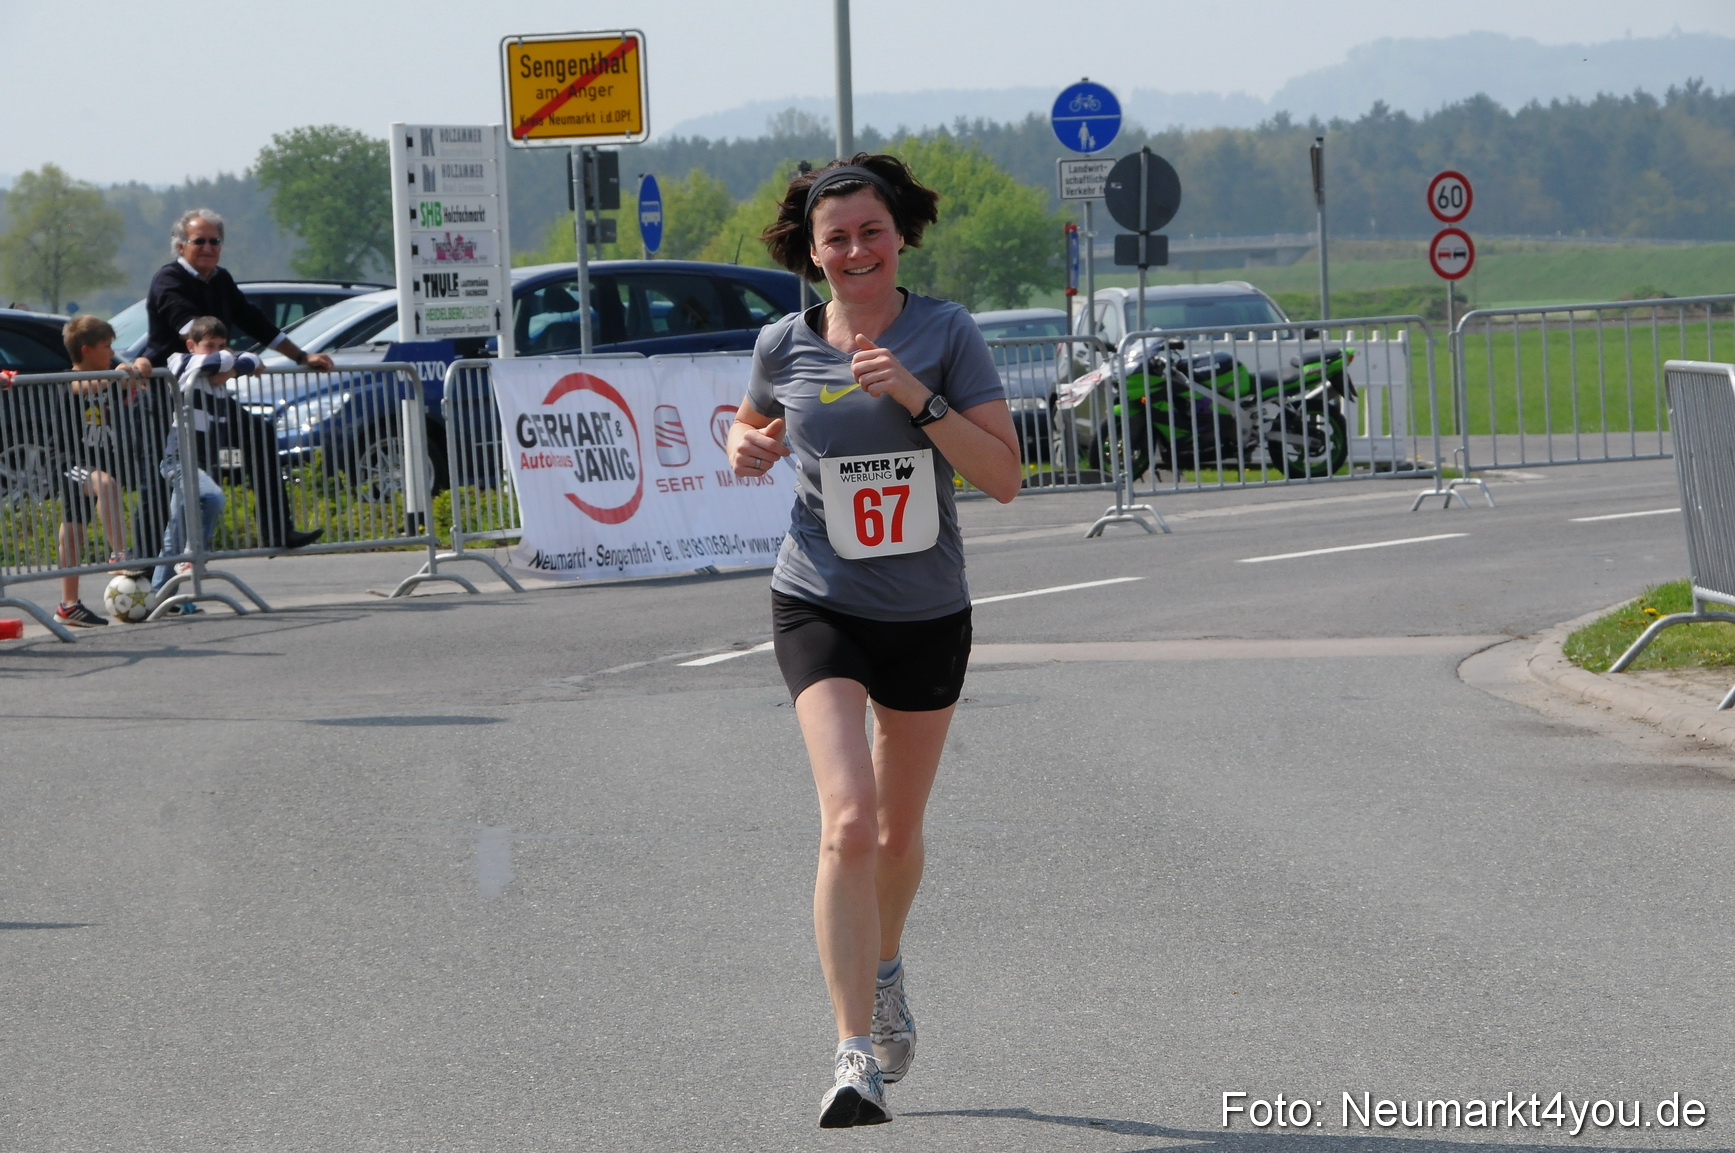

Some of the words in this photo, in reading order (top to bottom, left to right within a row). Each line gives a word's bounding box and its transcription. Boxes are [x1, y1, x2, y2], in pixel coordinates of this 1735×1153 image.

[520, 50, 628, 83] Sengenthal
[536, 87, 559, 100] am
[567, 84, 614, 101] Anger
[520, 113, 544, 126] Kreis
[548, 111, 596, 126] Neumarkt
[1065, 174, 1109, 185] schaftliche
[1065, 186, 1096, 196] Verkehr
[1437, 185, 1463, 209] 60
[420, 201, 442, 228] SHB
[423, 272, 459, 298] THULE
[516, 411, 615, 448] GERHART
[615, 420, 623, 437] &
[520, 449, 573, 469] Autohaus
[574, 446, 636, 483] JÄNIG
[840, 459, 891, 475] MEYER
[656, 475, 704, 493] SEAT
[715, 470, 735, 487] KIA
[840, 471, 893, 483] WERBUNG
[853, 484, 911, 547] 67
[528, 546, 587, 570] Neumarkt
[596, 542, 652, 571] Sengenthal
